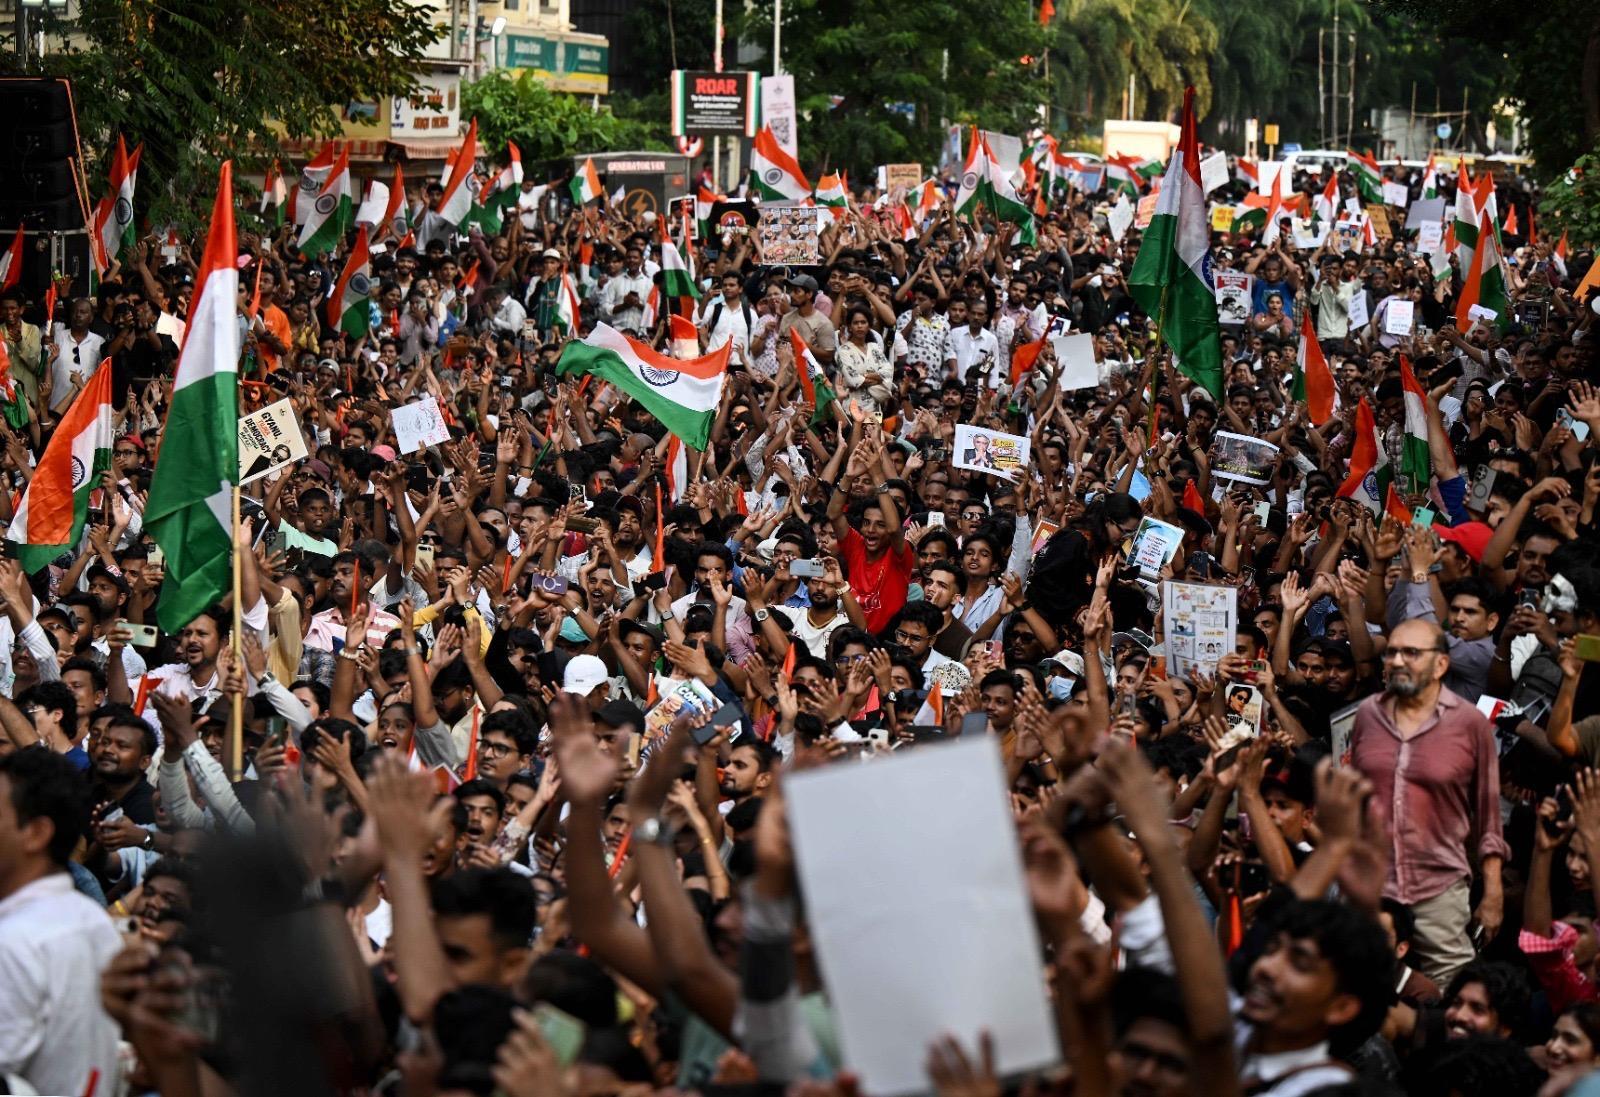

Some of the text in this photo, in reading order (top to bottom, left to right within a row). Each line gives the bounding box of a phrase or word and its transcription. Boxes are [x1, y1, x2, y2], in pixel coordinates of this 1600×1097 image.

[695, 78, 737, 95] ROAR
[244, 418, 272, 453] DEMOCRACY
[261, 411, 282, 440] GYANU,
